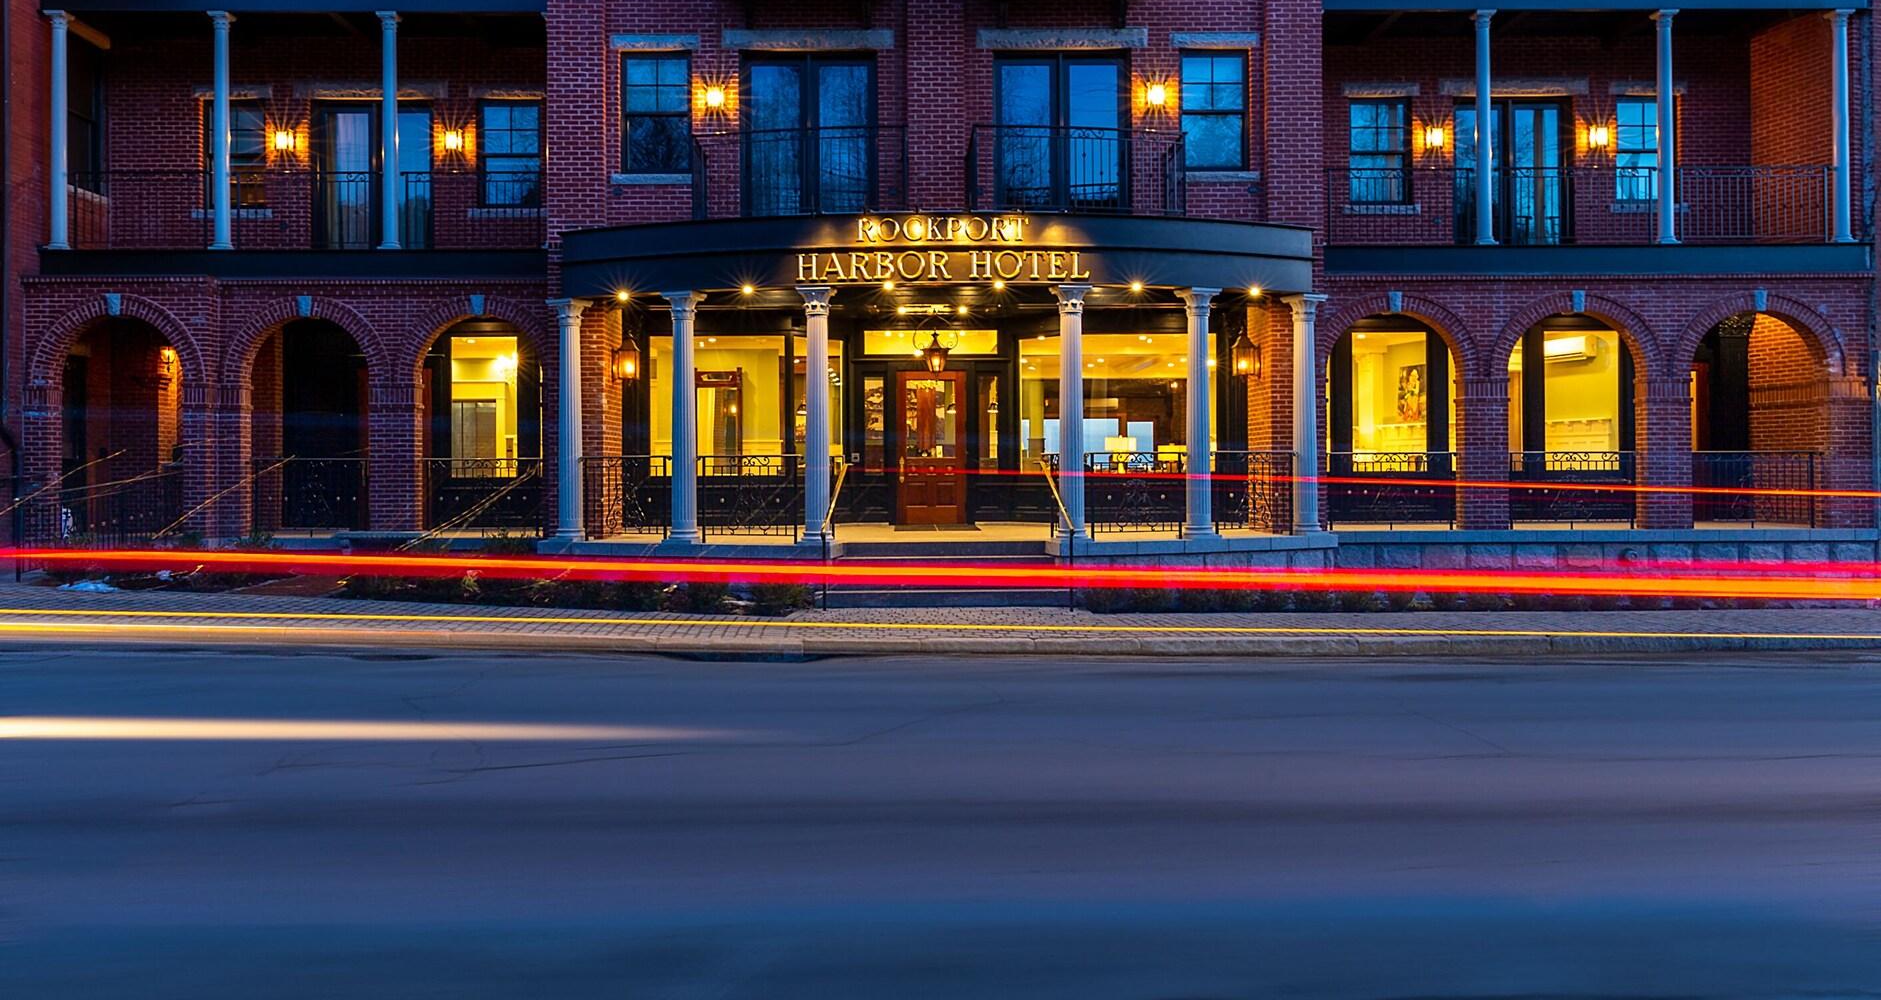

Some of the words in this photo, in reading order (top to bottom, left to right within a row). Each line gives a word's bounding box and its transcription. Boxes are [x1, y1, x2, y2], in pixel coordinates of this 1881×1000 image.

[856, 216, 1029, 242] ROCKPORT
[796, 250, 952, 281] HARBOR
[969, 250, 1090, 280] HOTEL
